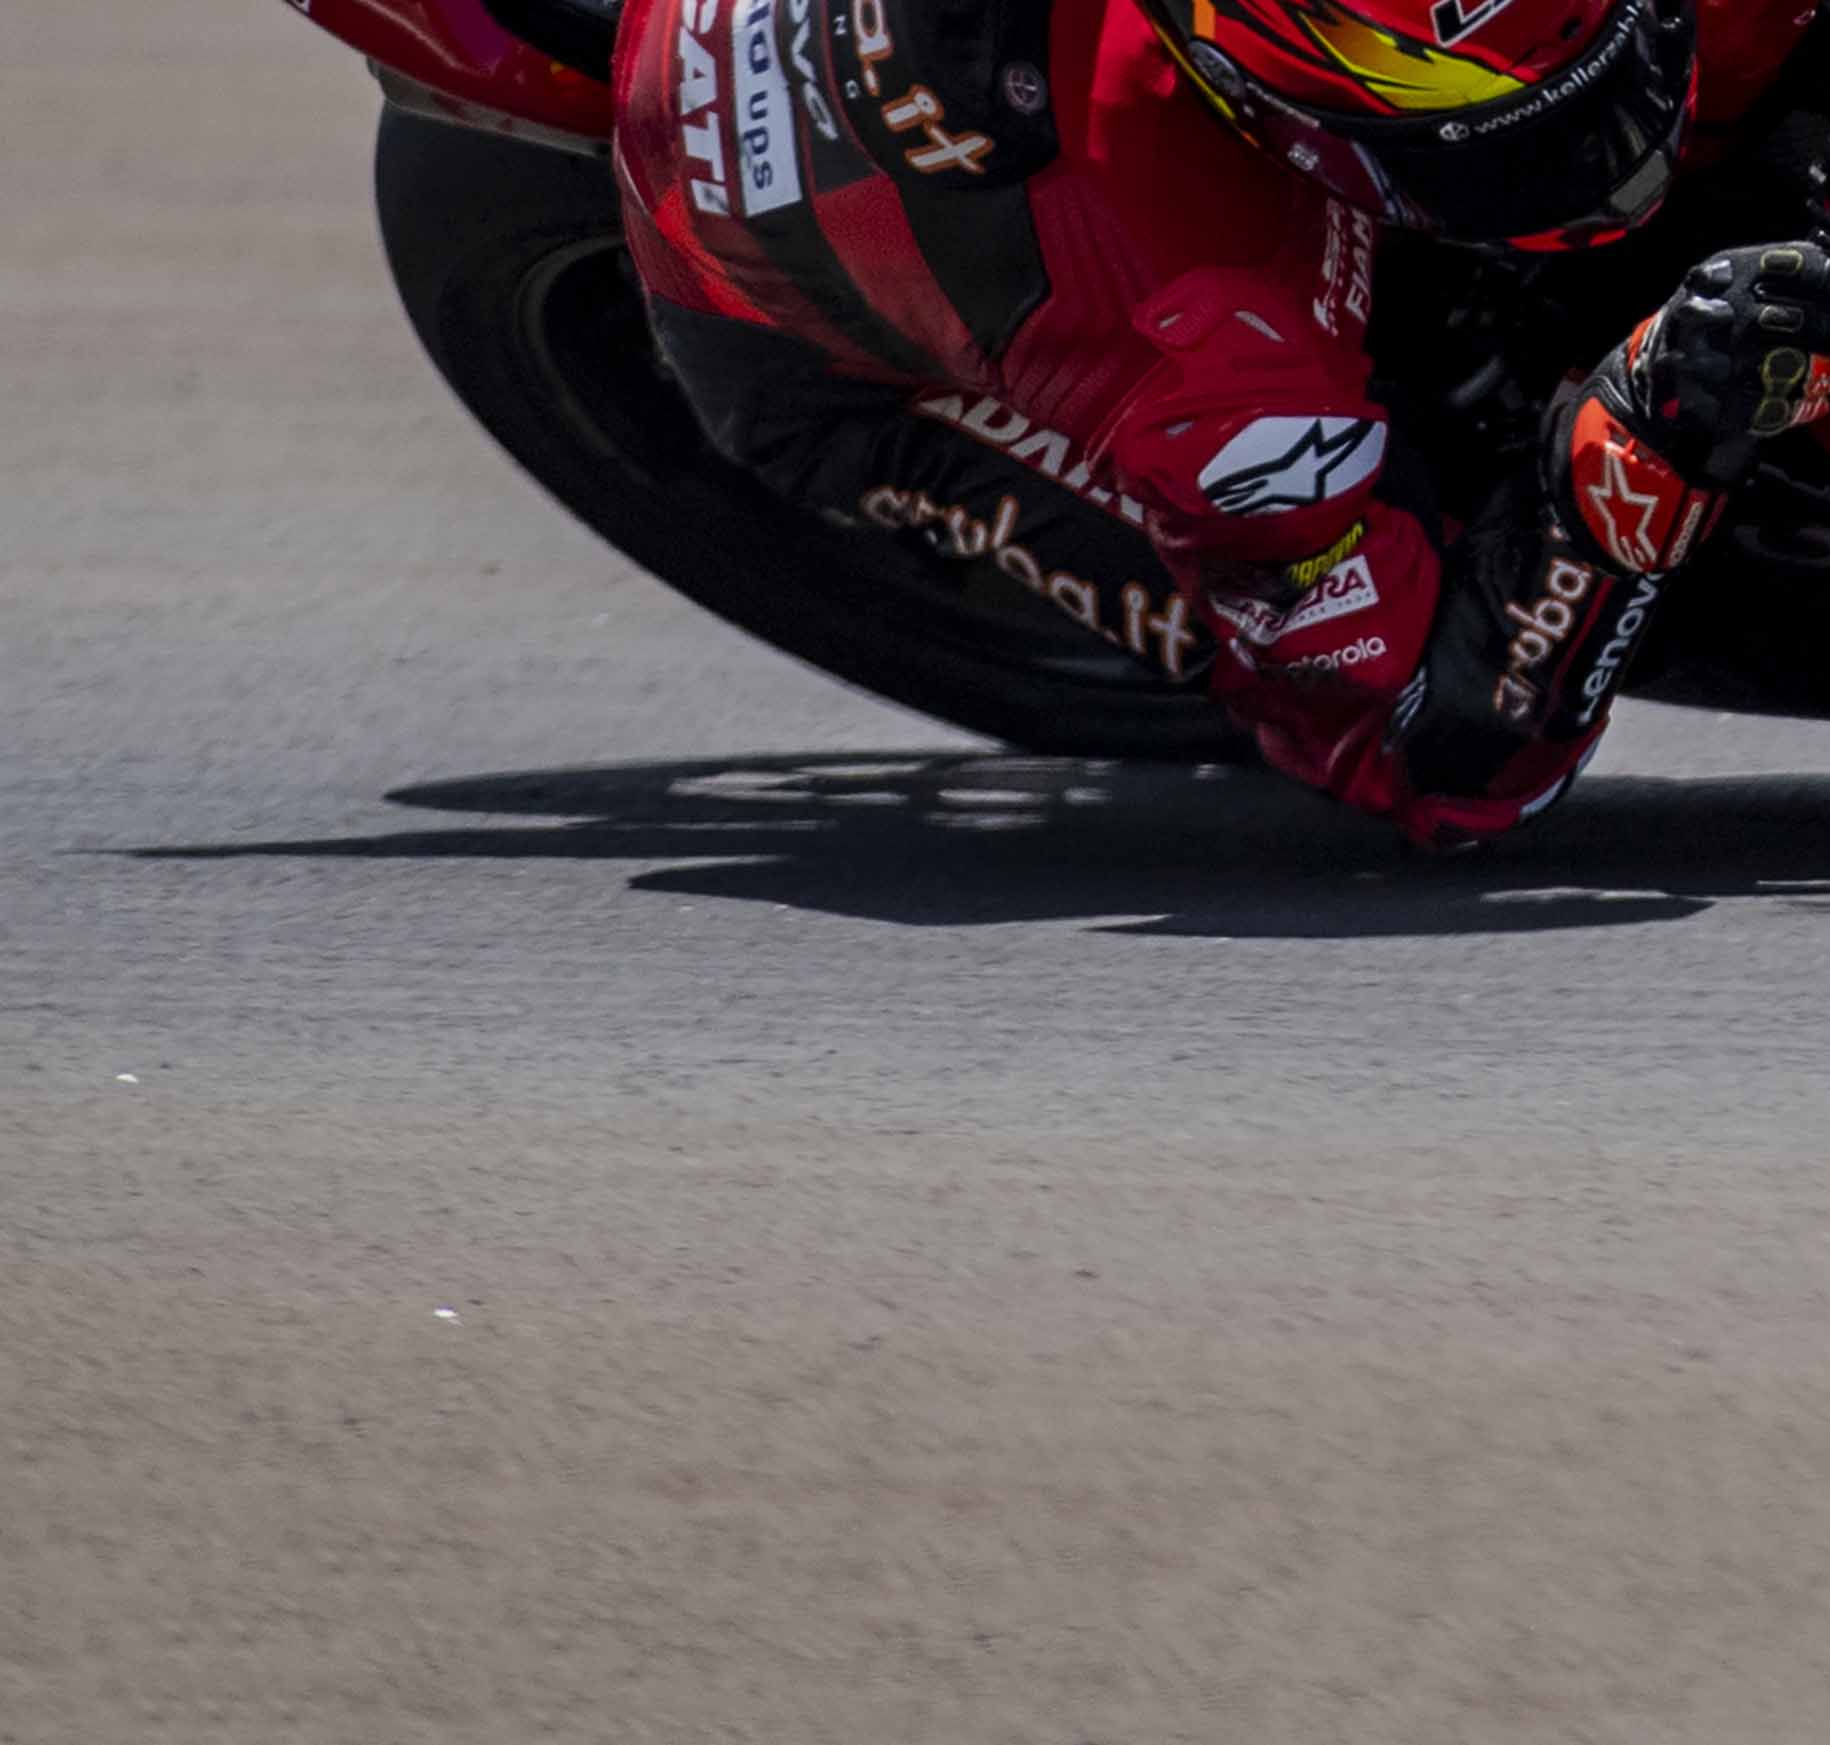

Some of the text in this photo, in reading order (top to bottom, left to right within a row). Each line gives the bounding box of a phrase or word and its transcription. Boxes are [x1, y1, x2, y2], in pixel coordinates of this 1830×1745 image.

[743, 88, 775, 193] ups
[857, 480, 1202, 686] aruba.it
[1493, 555, 1593, 719] aruba
